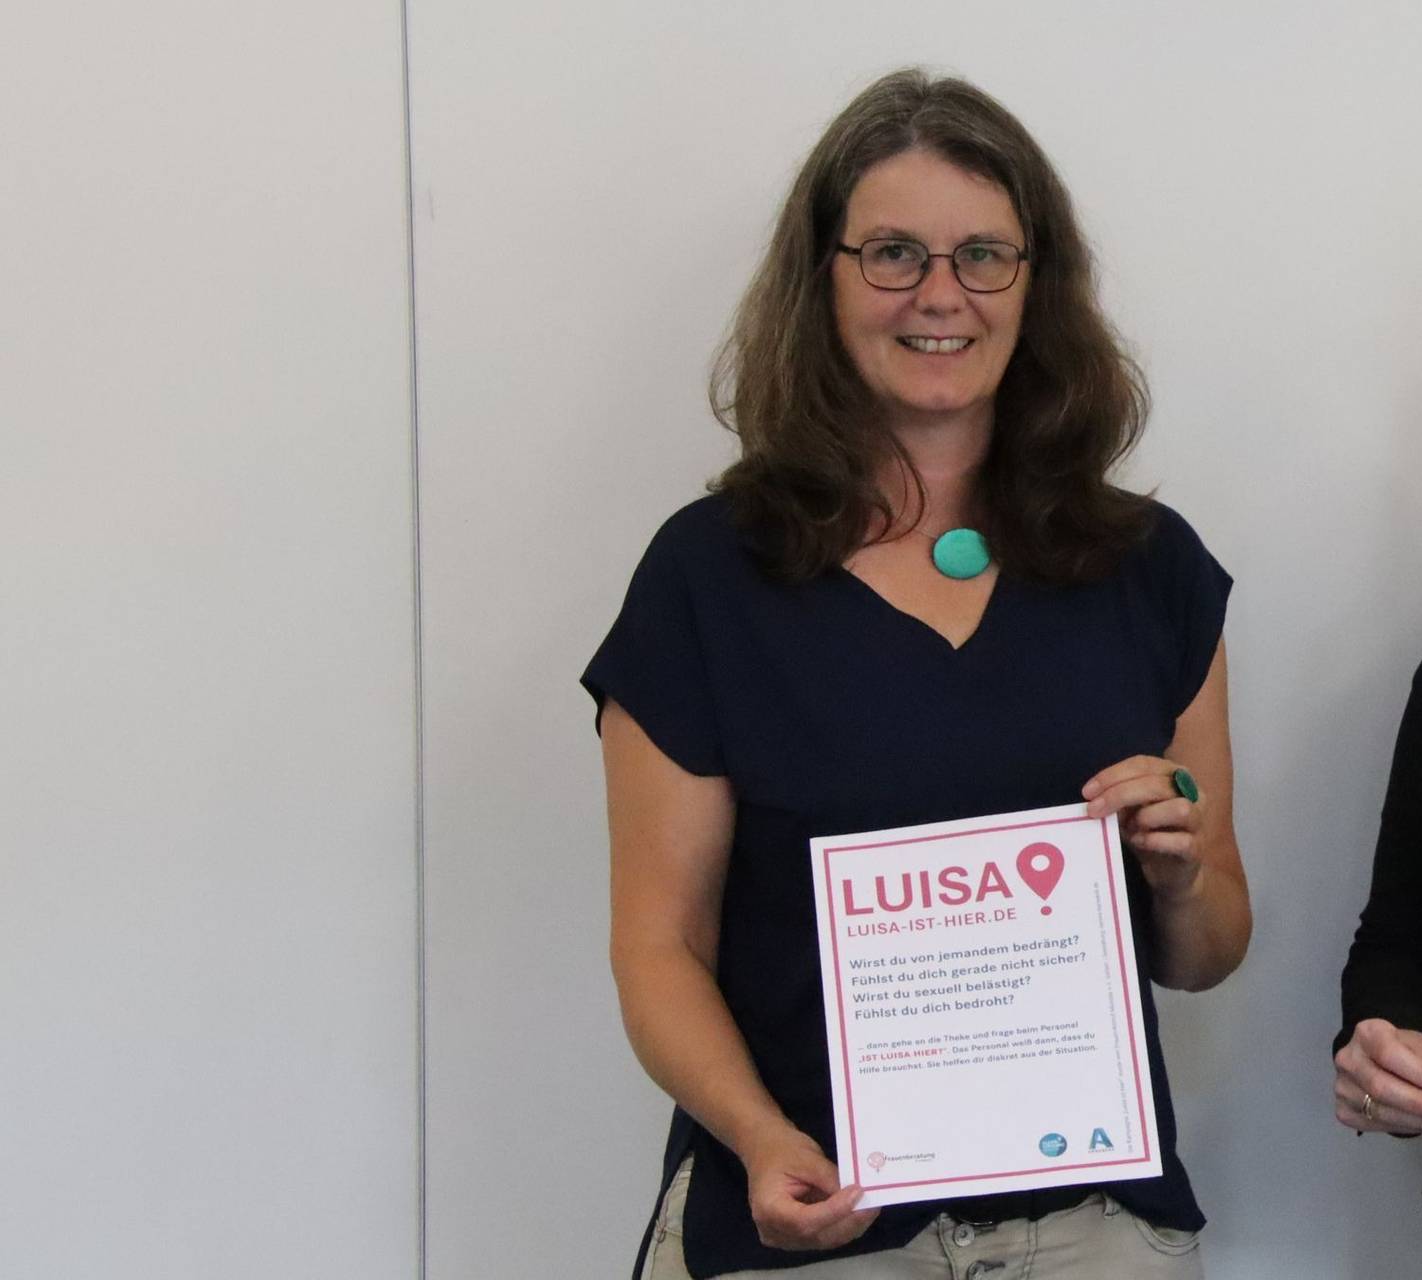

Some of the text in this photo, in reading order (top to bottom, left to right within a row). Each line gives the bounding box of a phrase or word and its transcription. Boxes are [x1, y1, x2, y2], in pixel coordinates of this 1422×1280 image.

[842, 861, 1014, 916] LUISA
[847, 907, 1017, 937] LUISA-IST-HIER.DE
[849, 935, 1080, 970] Wirst du von jemandem bedrängt?
[852, 951, 1087, 987] Fühlst du dich gerade nicht sicher?
[853, 975, 1031, 1003] Wirst du sexuell belästigt?
[855, 994, 1015, 1020] Fühlst du dich bedroht?
[866, 1041, 889, 1050] dann
[891, 1039, 913, 1049] gehe
[915, 1038, 926, 1046] an
[927, 1036, 941, 1045] die
[943, 1033, 970, 1042] Theke
[972, 1031, 989, 1040] und
[991, 1028, 1014, 1038] frage
[1016, 1025, 1039, 1035] beim
[1040, 1020, 1079, 1032] Personal
[880, 1050, 911, 1061] LUISA
[952, 1045, 969, 1054] Das
[971, 1041, 1009, 1053] Personal
[1060, 1033, 1082, 1042] dass
[1084, 1031, 1096, 1039] du
[858, 1066, 880, 1075] Hilfe
[927, 1060, 941, 1068] Sie
[943, 1057, 970, 1067] helfen
[972, 1055, 984, 1063] dir
[987, 1052, 1018, 1063] diskret
[1020, 1051, 1036, 1059] aus
[1038, 1048, 1053, 1056] der
